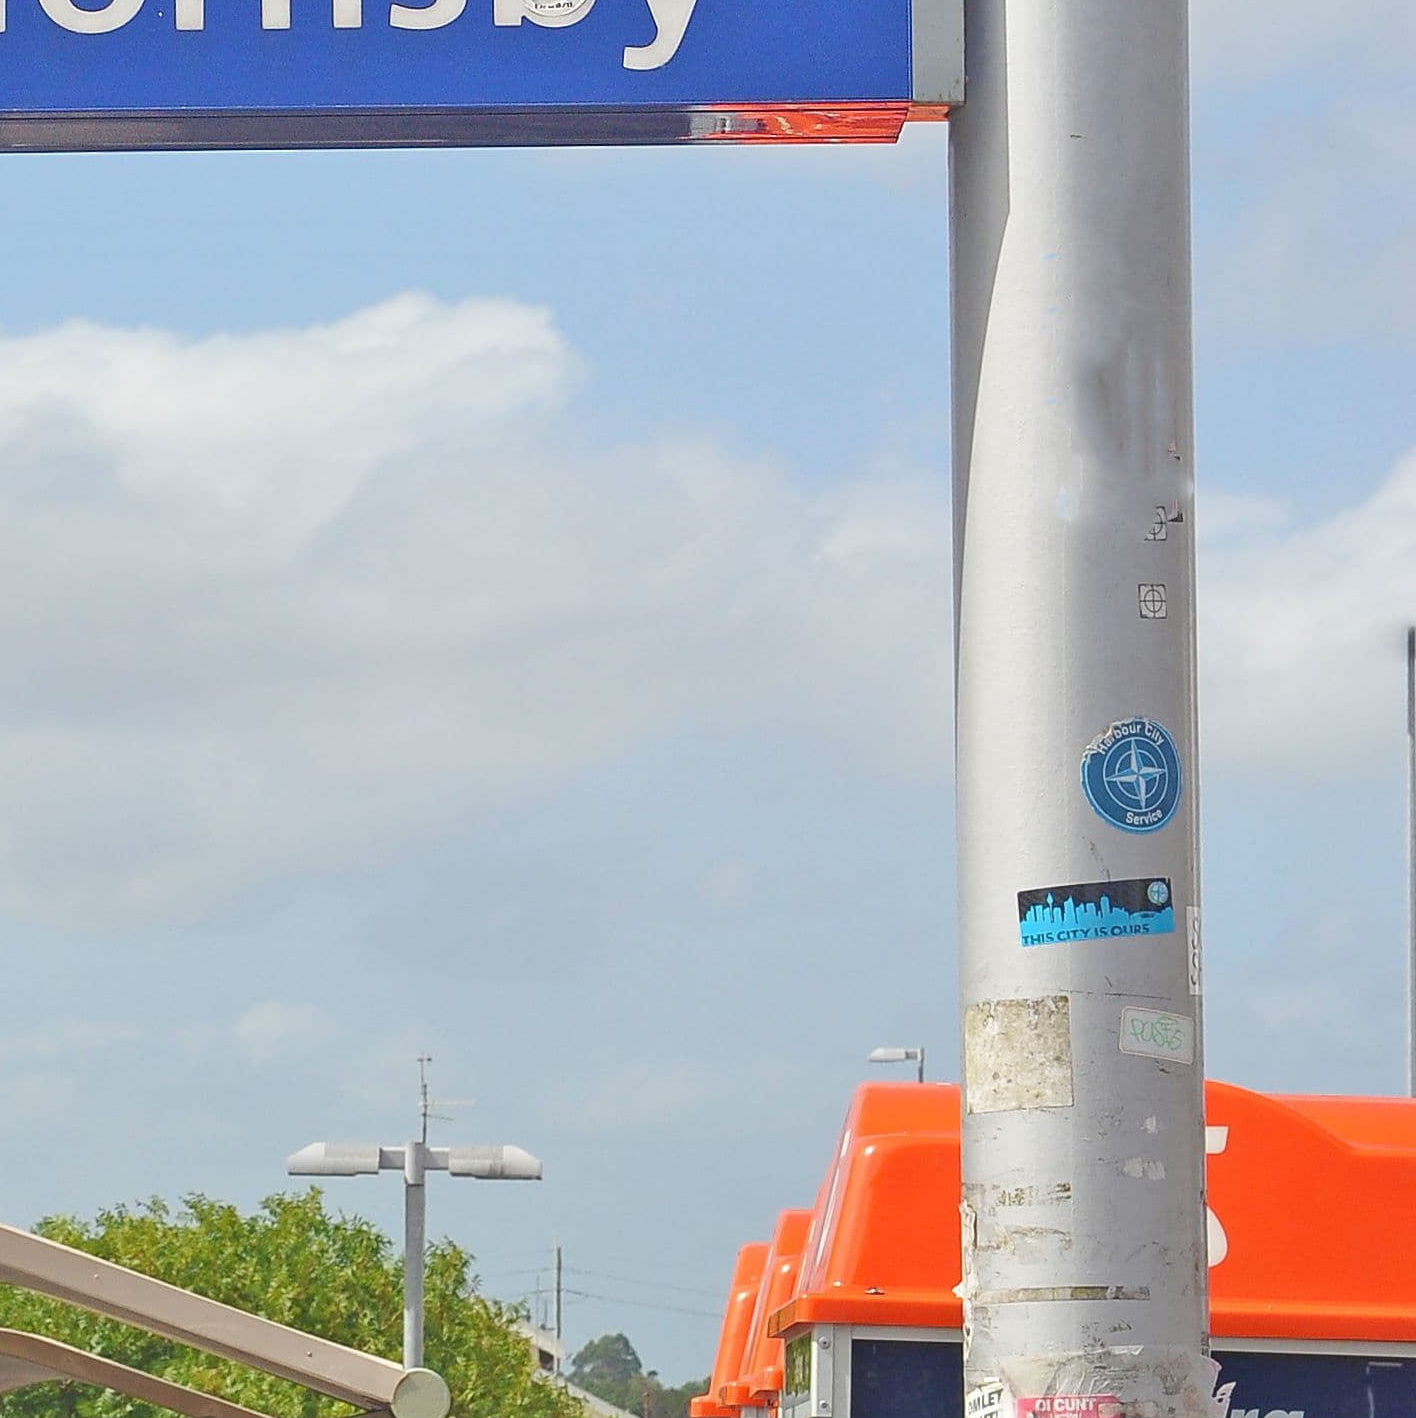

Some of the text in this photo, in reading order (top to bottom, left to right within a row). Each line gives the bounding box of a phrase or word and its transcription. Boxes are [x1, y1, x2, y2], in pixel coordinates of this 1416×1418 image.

[1096, 722, 1165, 755] Harbour City
[1125, 809, 1163, 825] Service
[1022, 923, 1150, 945] THIS CITY IS OURS
[1035, 1397, 1097, 1412] OI CUNT
